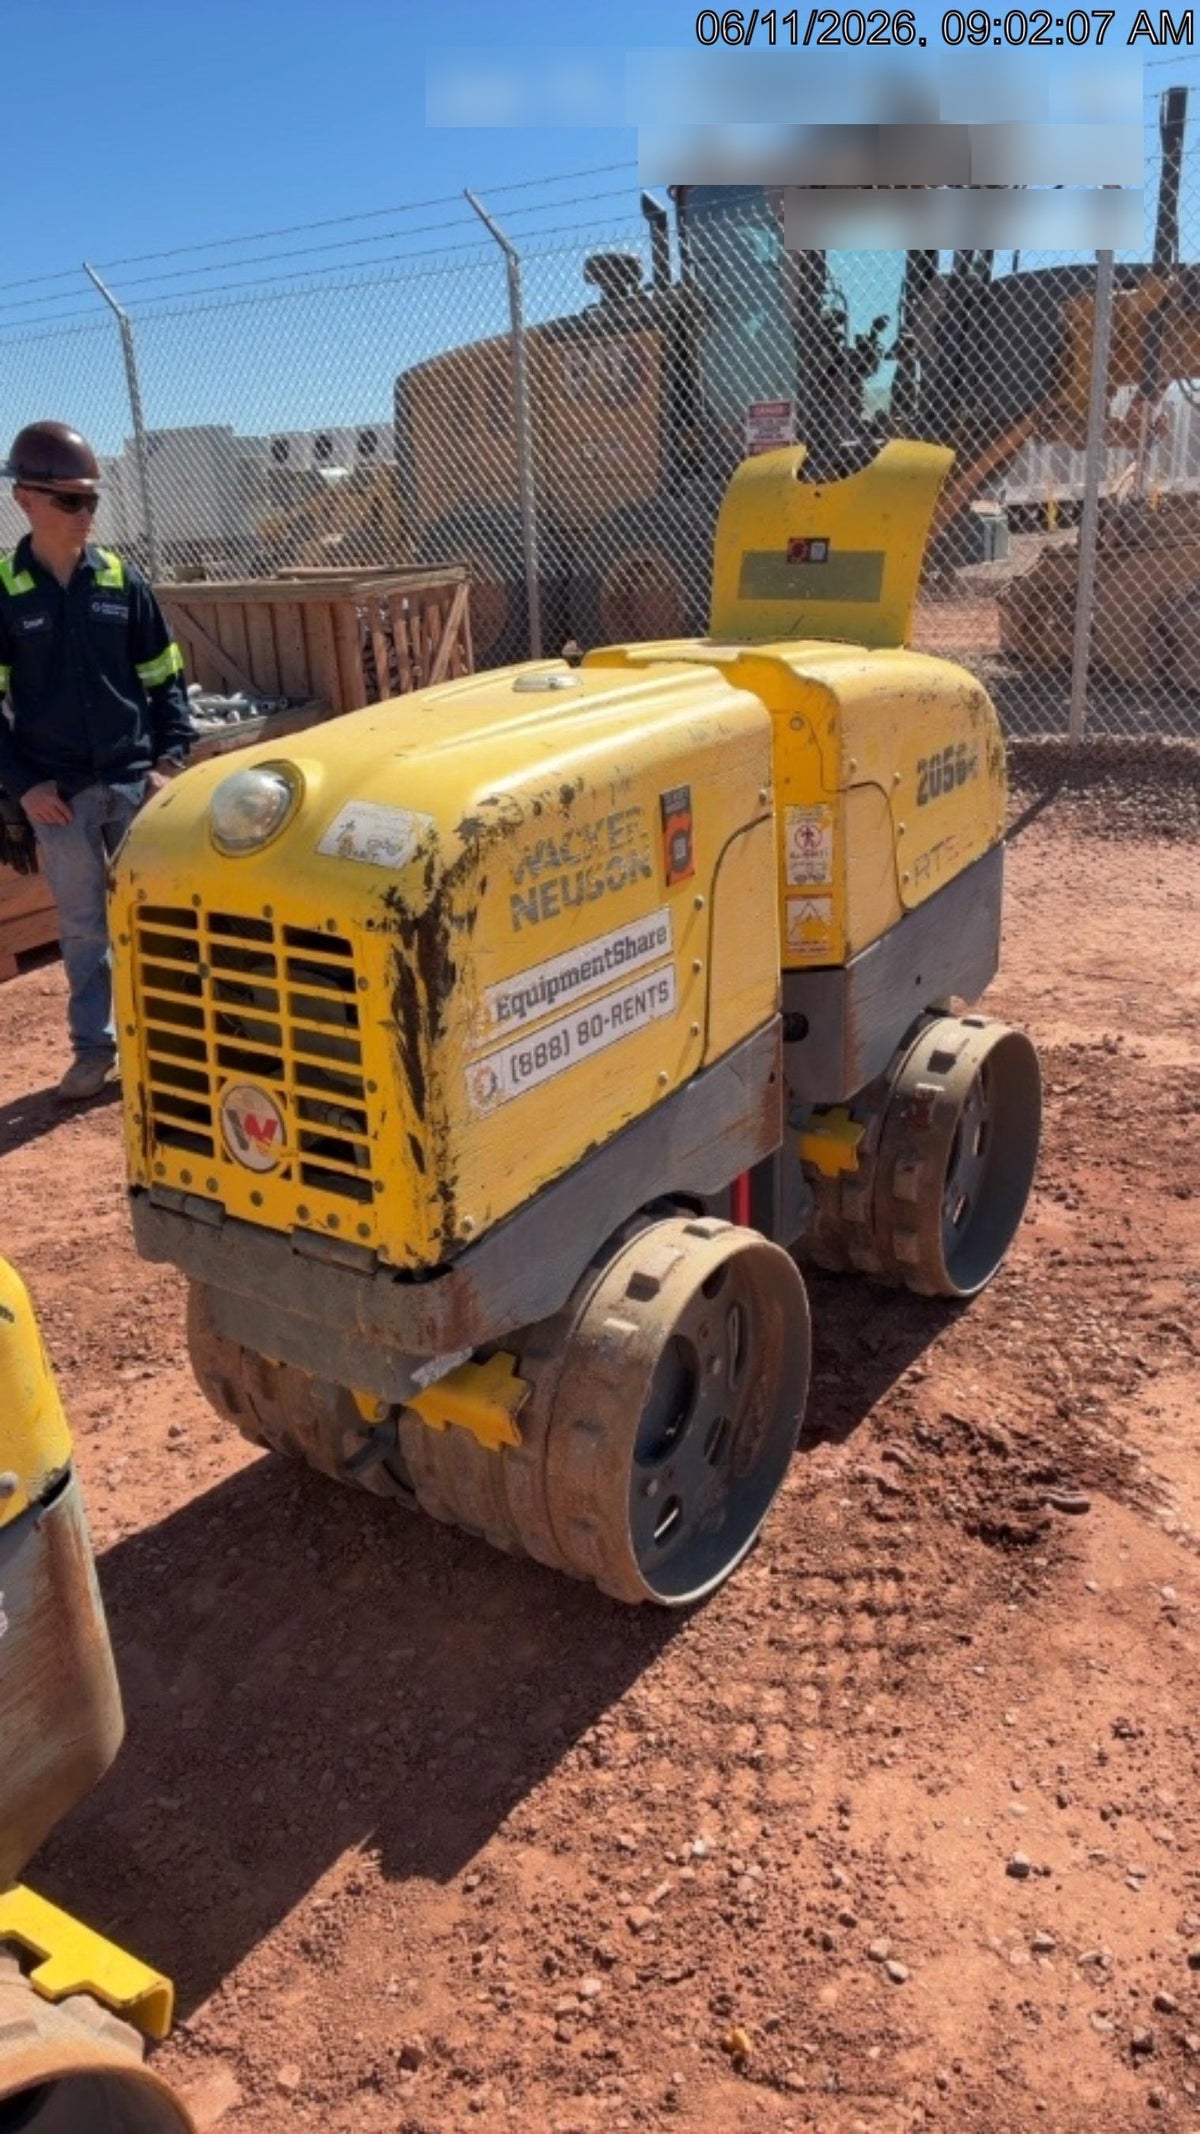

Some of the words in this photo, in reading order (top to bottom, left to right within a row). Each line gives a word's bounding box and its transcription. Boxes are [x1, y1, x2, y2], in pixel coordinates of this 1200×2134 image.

[496, 925, 667, 1022] EquipmentShare
[510, 1028, 570, 1083] (888)
[577, 980, 670, 1046] 80-RENTS
